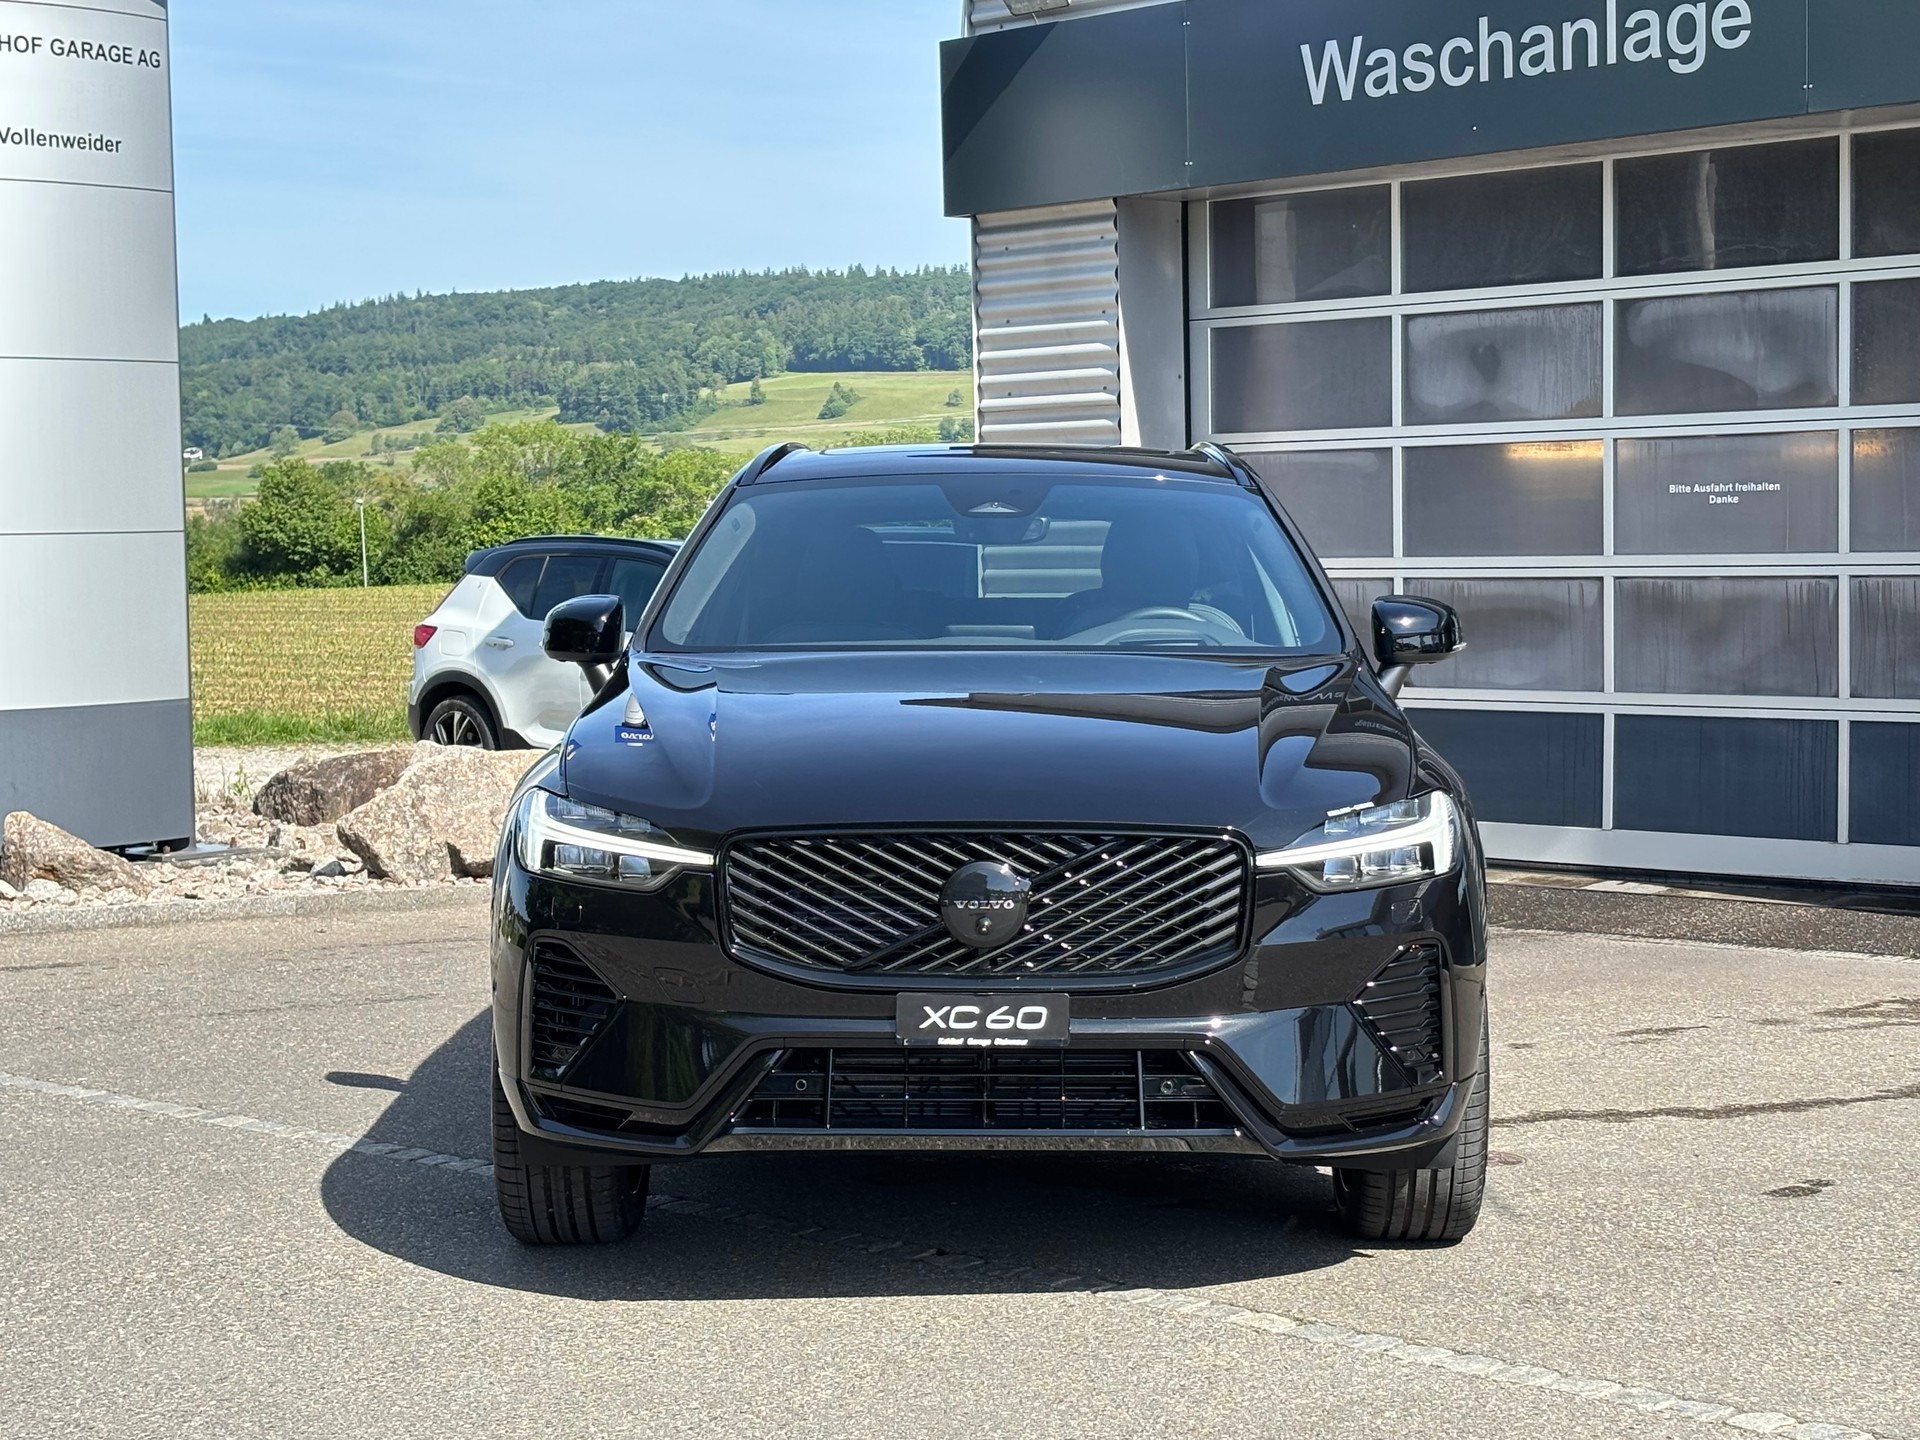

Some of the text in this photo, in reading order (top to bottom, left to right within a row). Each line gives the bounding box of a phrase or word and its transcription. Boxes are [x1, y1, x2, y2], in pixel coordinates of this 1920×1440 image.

[0, 34, 161, 69] HOF GARAGE AG
[1300, 0, 1752, 106] Waschanlage
[0, 127, 122, 153] Vollenweider
[1669, 482, 1781, 493] Bitte Ausfahrt freihalten
[1709, 495, 1739, 504] Danke
[953, 900, 1015, 910] VOLVO
